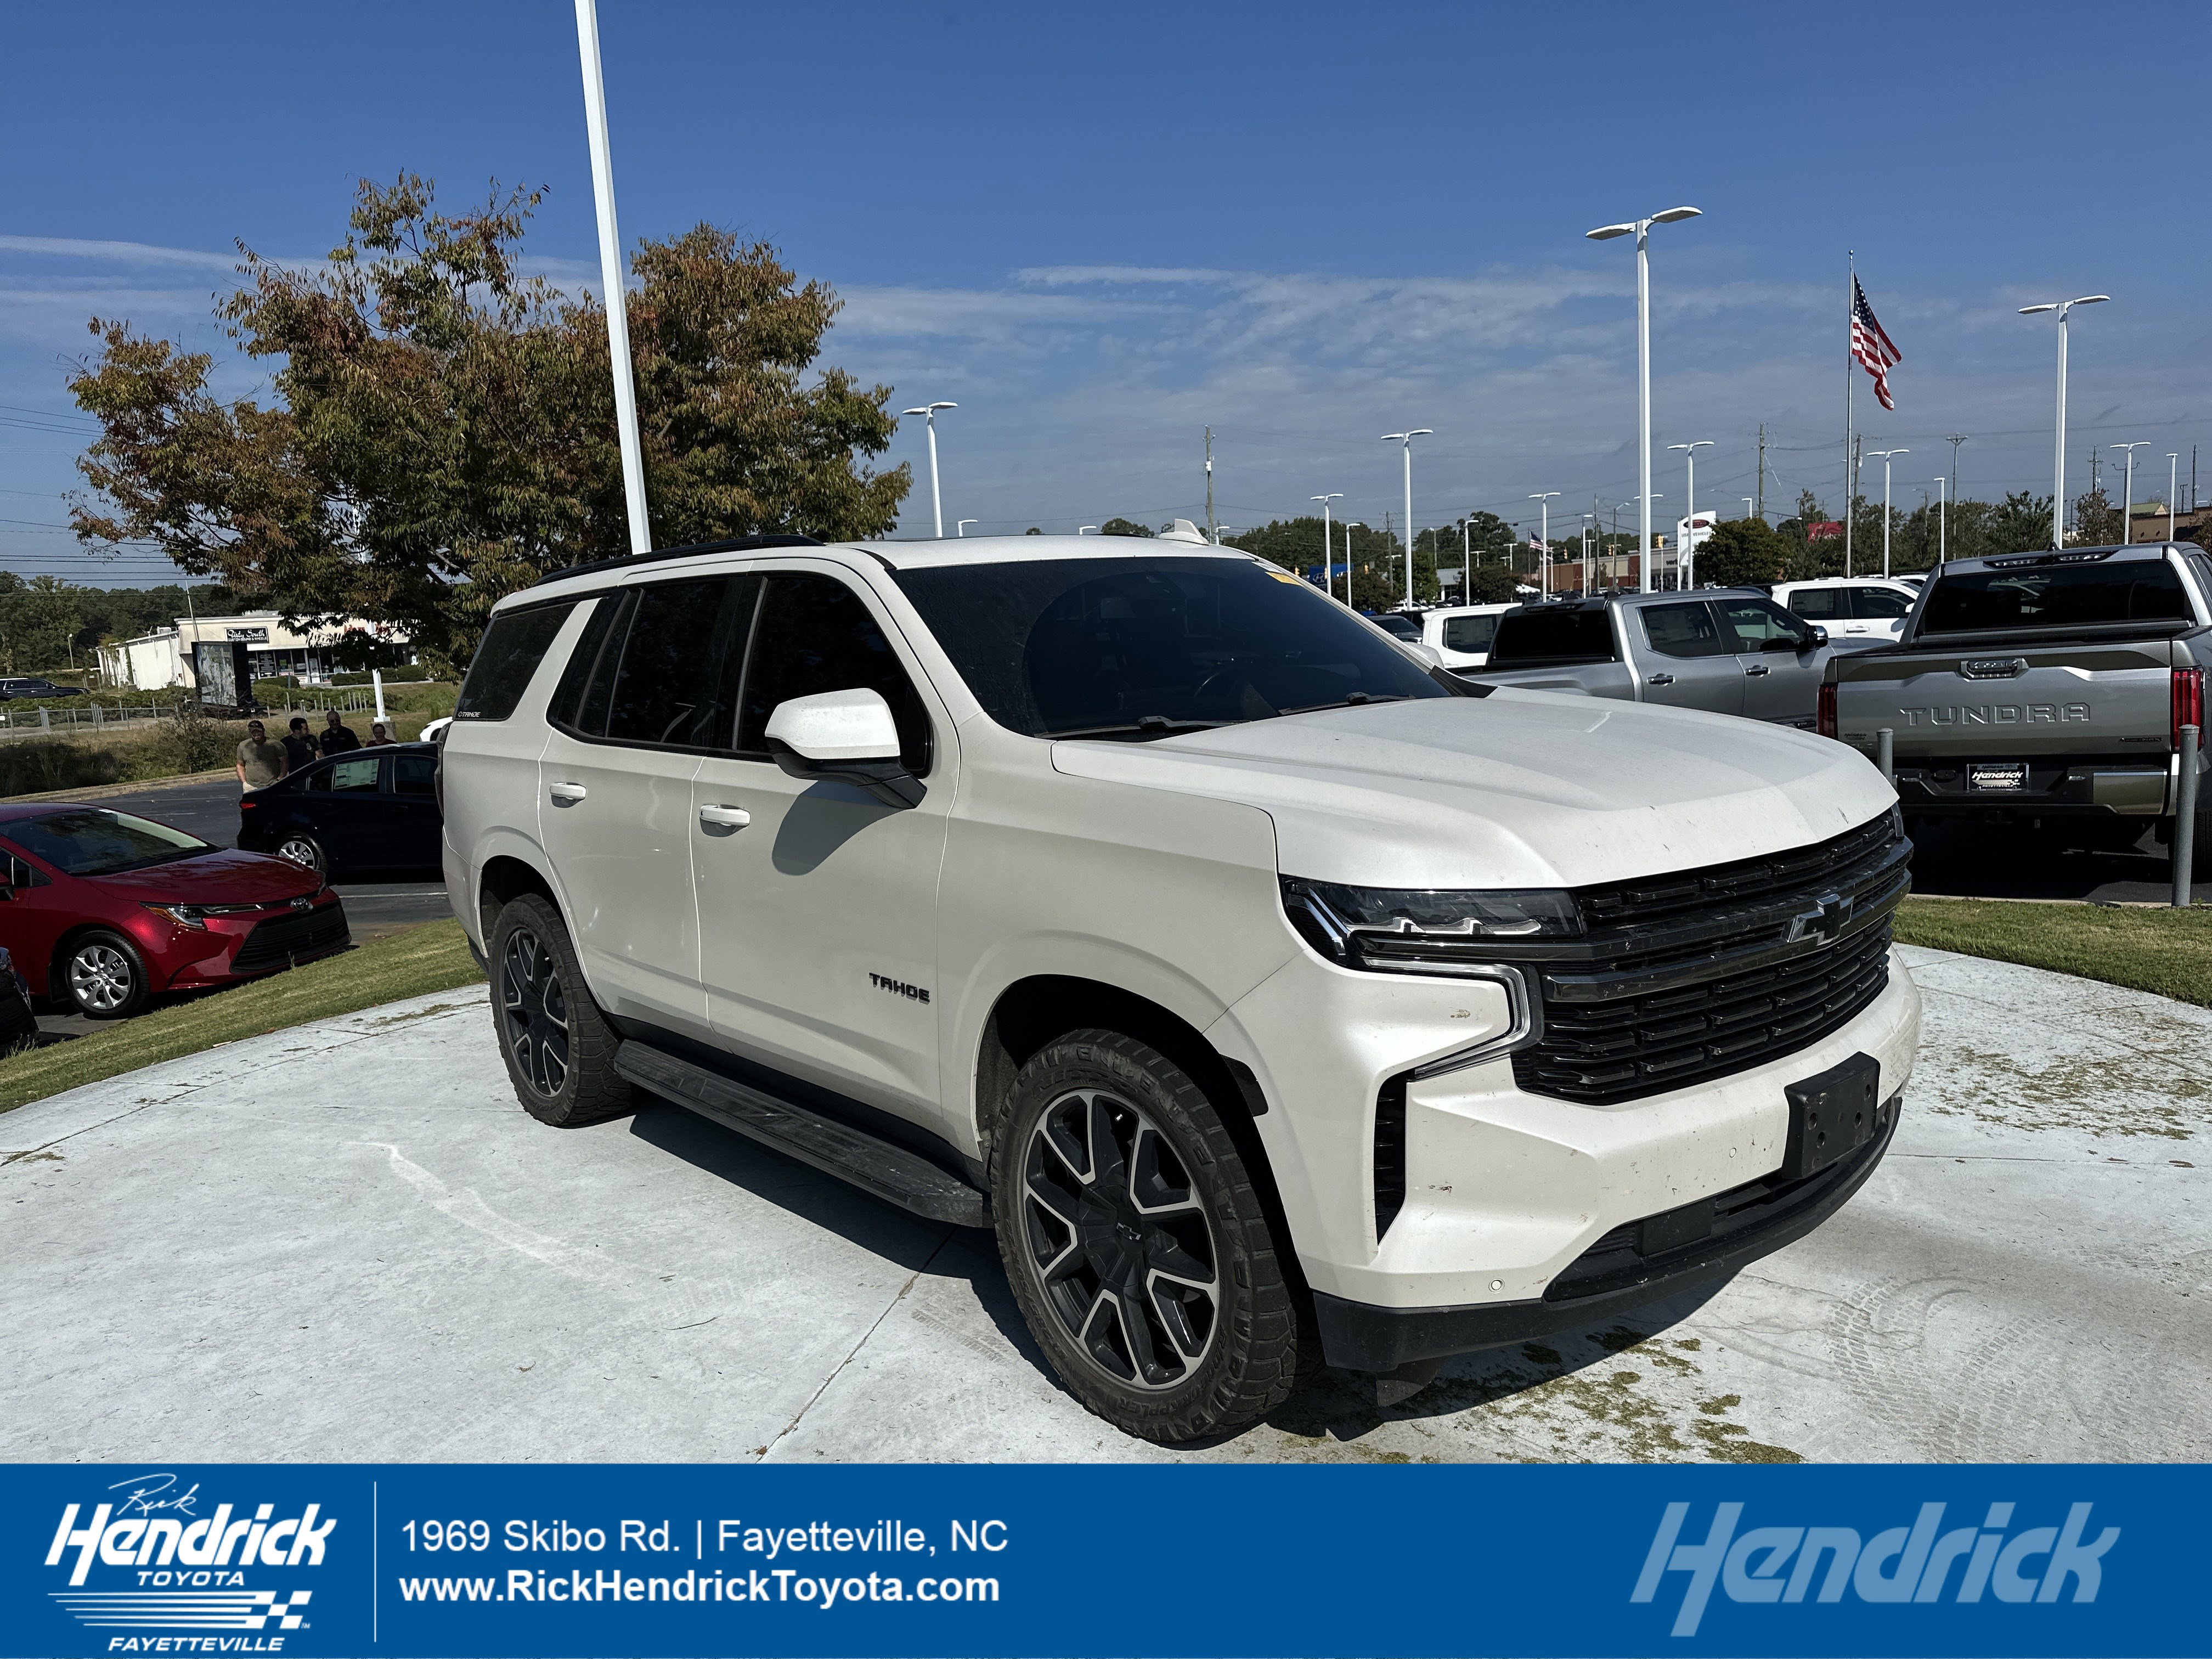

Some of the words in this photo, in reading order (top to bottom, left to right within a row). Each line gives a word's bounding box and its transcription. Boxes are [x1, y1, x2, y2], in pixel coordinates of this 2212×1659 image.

[246, 629, 265, 637] South
[1900, 702, 2091, 726] TUNDRA
[1972, 771, 2023, 780] Hendrick
[869, 972, 930, 1005] TAHOE
